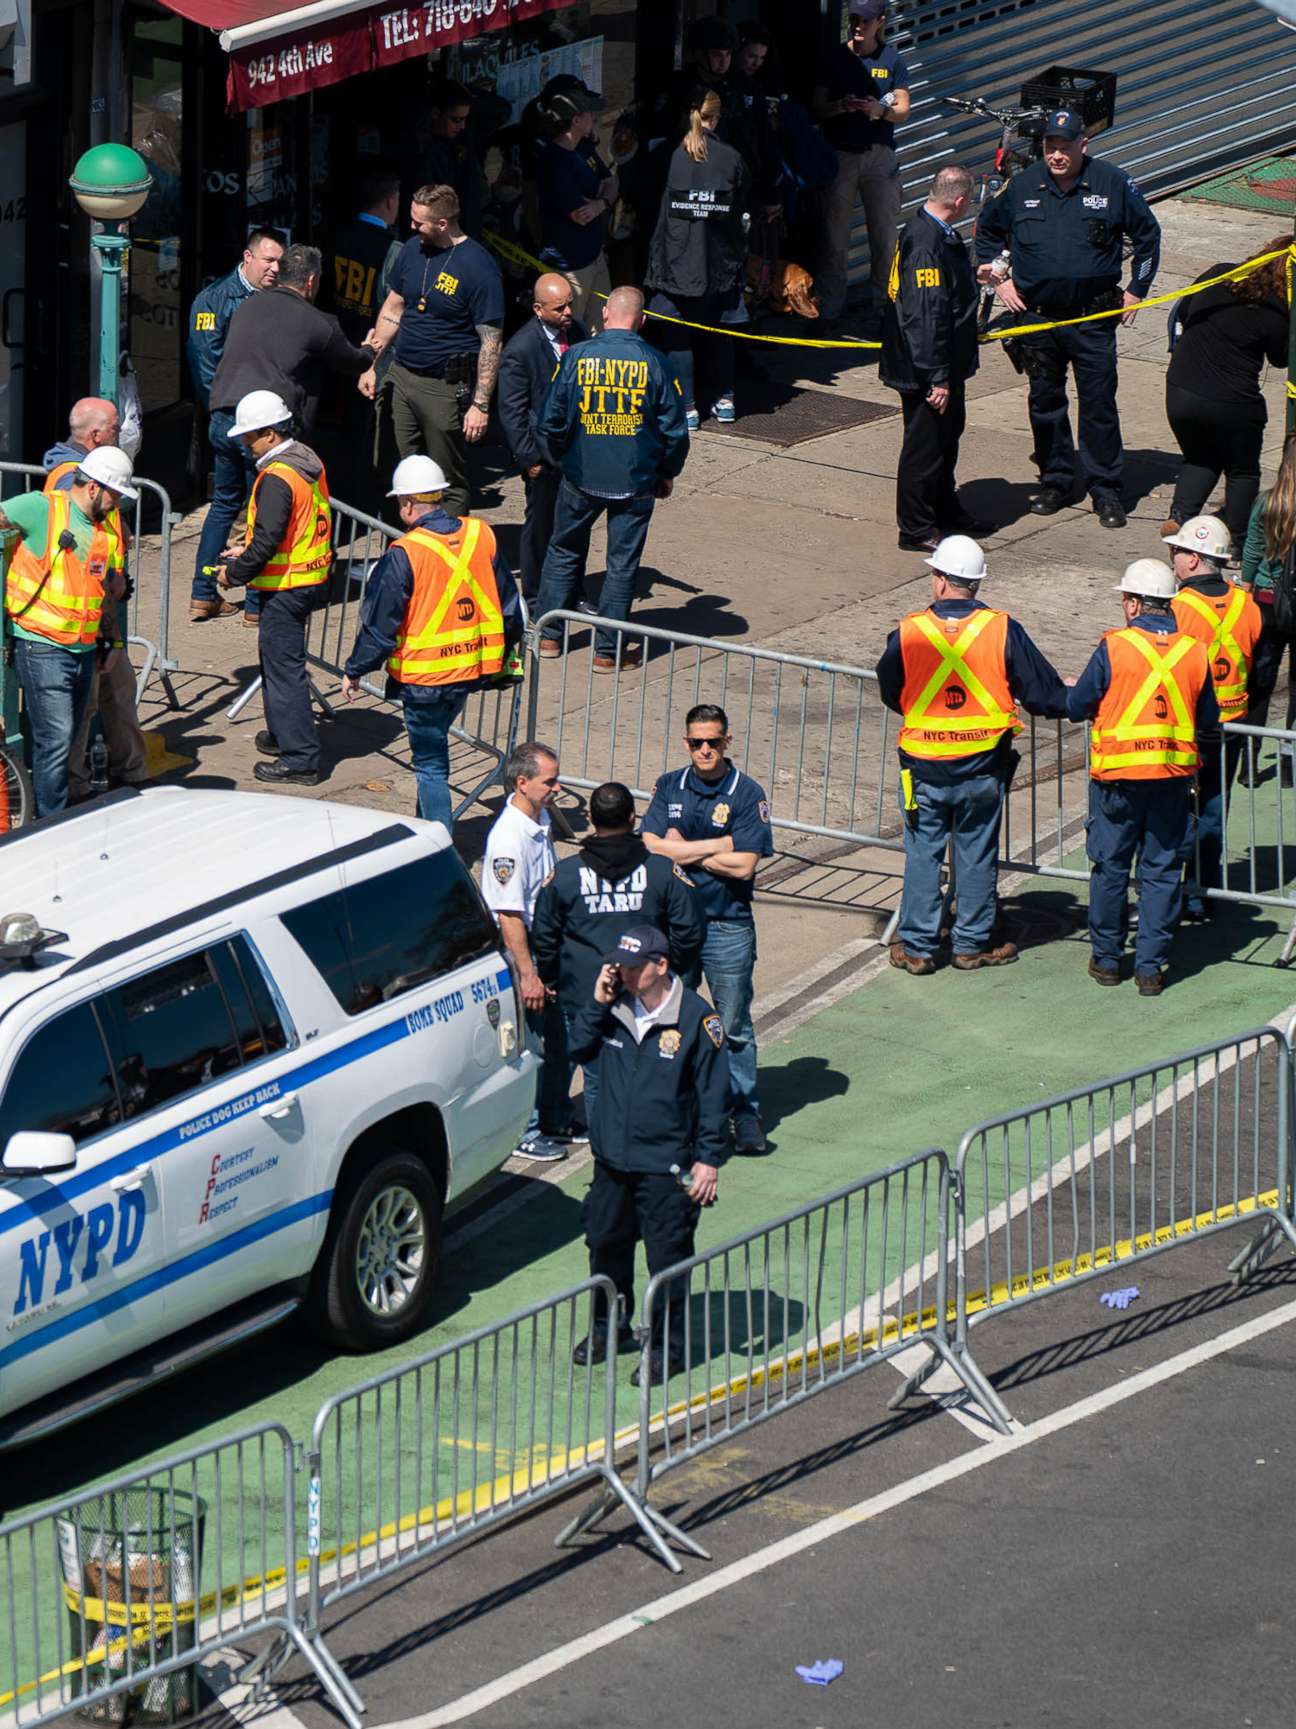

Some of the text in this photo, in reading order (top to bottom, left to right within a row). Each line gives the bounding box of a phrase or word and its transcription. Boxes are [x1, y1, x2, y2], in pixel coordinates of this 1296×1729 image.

[381, 8, 420, 49] TEL:
[247, 42, 333, 87] 942 4th Ave
[872, 68, 888, 79] FBI
[689, 190, 715, 202] FBI
[1082, 196, 1108, 207] POLICE
[334, 255, 377, 308] FBI
[437, 271, 459, 290] FBI
[916, 268, 940, 289] FBI
[195, 311, 216, 331] FBI
[577, 357, 648, 388] FBI-NYPD
[578, 385, 646, 414] JTTF
[585, 423, 636, 437] TASK FORCE
[600, 413, 644, 426] TERRORIST
[439, 644, 462, 658] NYC
[923, 730, 989, 742] NYC Transit
[1134, 739, 1154, 751] NYC
[584, 892, 644, 914] TARU
[407, 976, 493, 1034] BOMB SQUAD 5674
[179, 1082, 281, 1140] POLICE DOG KEEP BACK
[211, 1146, 255, 1176] COURTESY
[206, 1155, 279, 1200] PROFESSIONALISM
[198, 1197, 239, 1224] RESPECT
[14, 1188, 146, 1316] NYPD
[308, 1480, 320, 1547] NYPD
